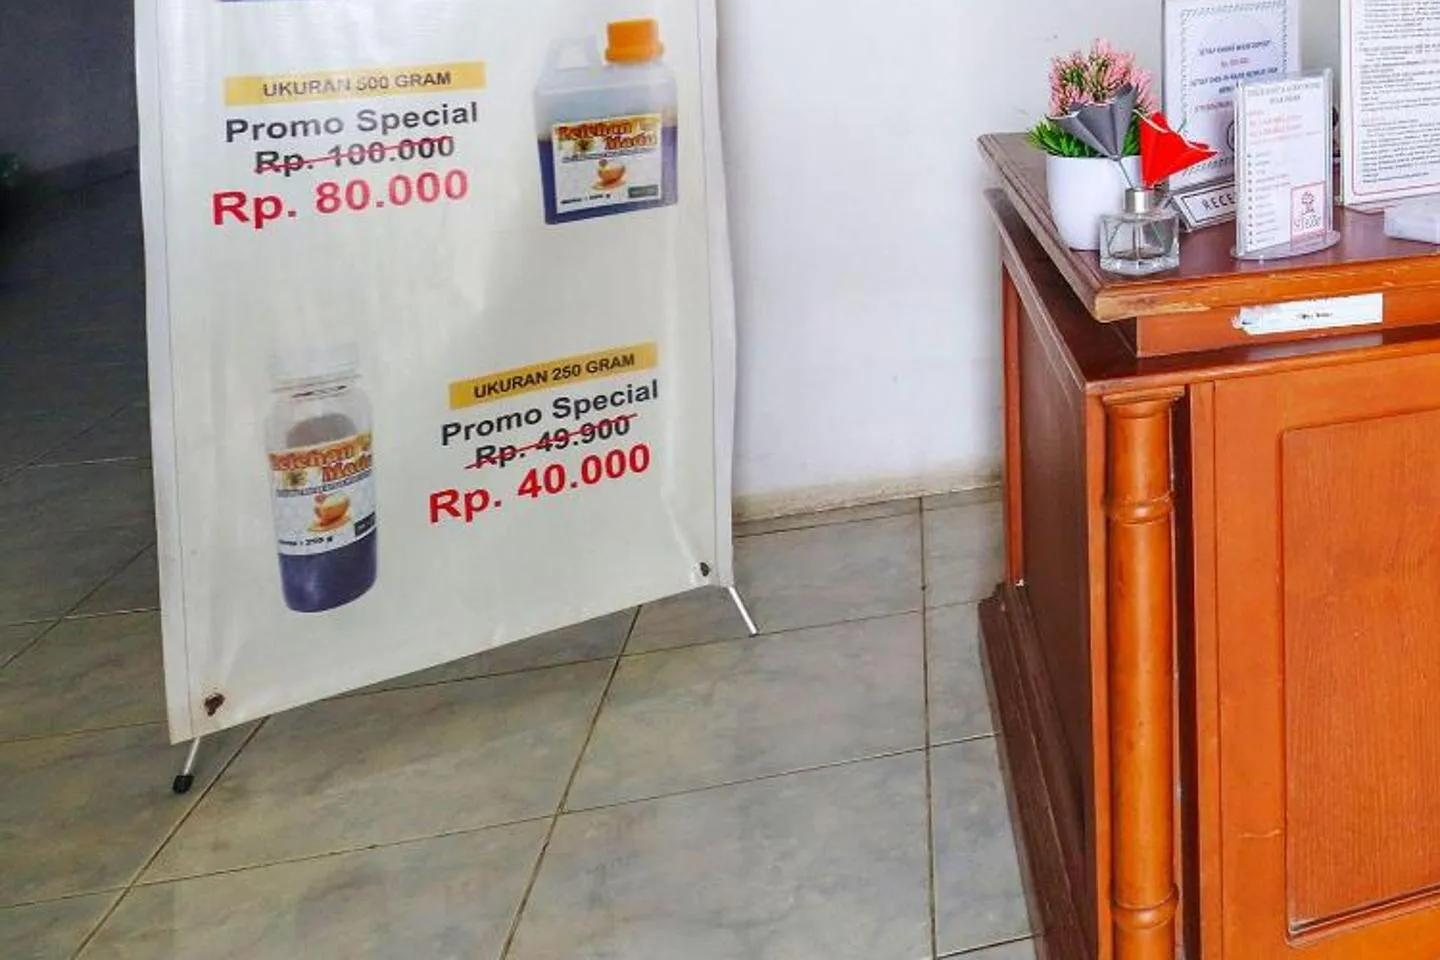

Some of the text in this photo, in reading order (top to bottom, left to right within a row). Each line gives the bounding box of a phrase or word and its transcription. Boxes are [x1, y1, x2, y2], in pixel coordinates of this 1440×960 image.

[262, 71, 452, 97] UKURAN 500 GRAM
[226, 101, 478, 143] Promo Special
[255, 135, 455, 178] Rp. 100.000
[212, 169, 468, 230] Rp. 80.000
[473, 352, 635, 399] UKURAN 250 GRAM
[441, 379, 658, 446] Promo Special
[474, 414, 631, 469] Rp. 49.900
[428, 488, 502, 524] Rp.
[517, 442, 650, 499] 40.000
